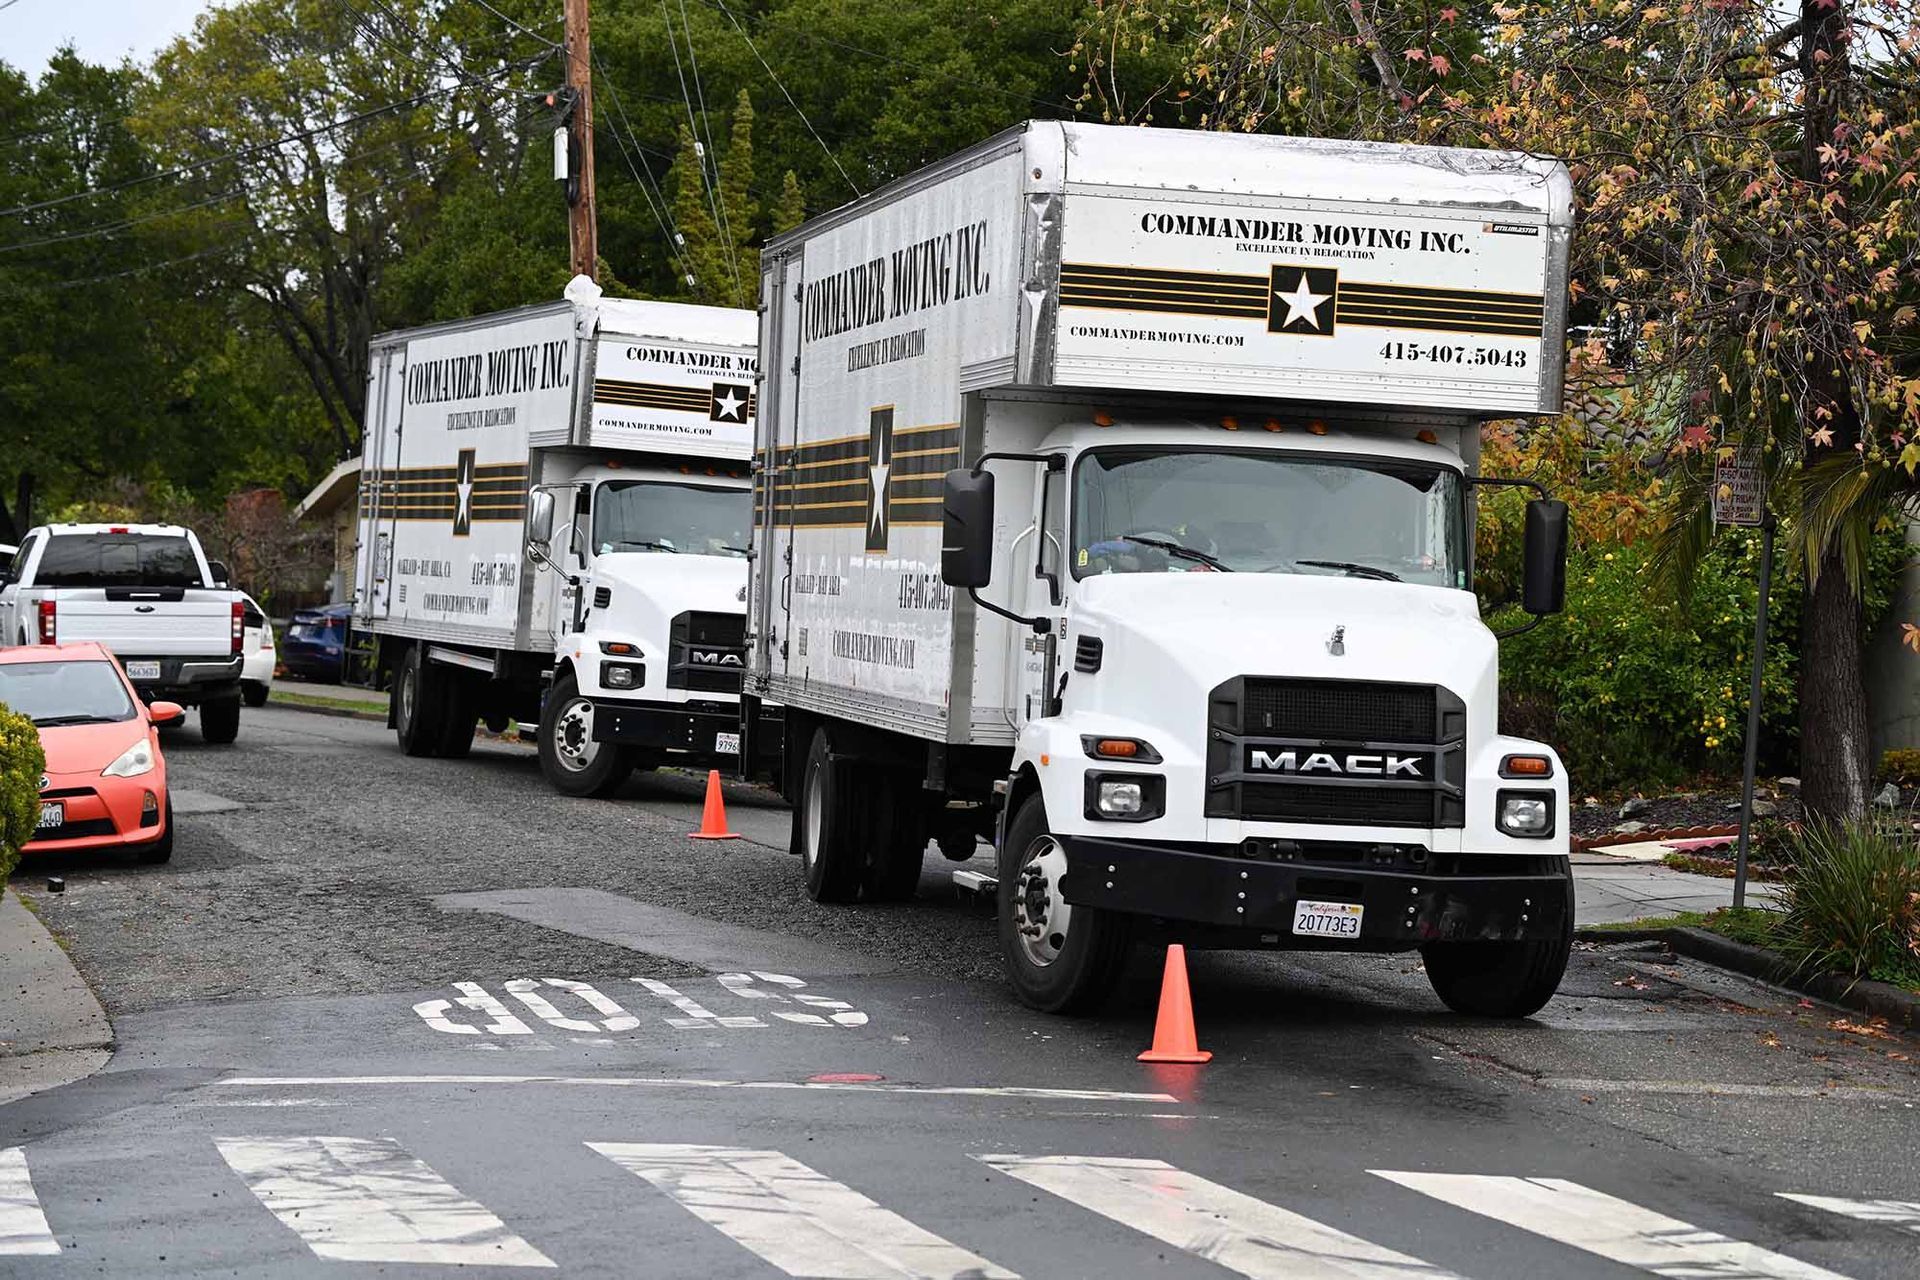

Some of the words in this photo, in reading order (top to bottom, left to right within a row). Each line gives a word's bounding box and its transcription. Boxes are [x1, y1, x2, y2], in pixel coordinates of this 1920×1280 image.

[1140, 212, 1304, 245] COMMANDER
[1309, 224, 1412, 252] MOVING
[1419, 231, 1471, 255] INC.
[1235, 242, 1297, 255] EXCELLENCE
[1299, 246, 1311, 256] IN
[1313, 247, 1376, 260] RELOCATION
[805, 256, 886, 345] COMMANDER
[890, 231, 953, 320] MOVING
[954, 218, 990, 302] INC.
[1069, 325, 1245, 348] COMMANDERMOVING.COM
[627, 346, 732, 370] COMMANDER
[1379, 341, 1528, 369] 415-407.5043
[408, 354, 483, 406] COMMANDER
[485, 344, 538, 397] MOVING
[540, 339, 569, 390] INC.
[687, 368, 726, 377] EXCELLENCE
[598, 418, 713, 436] COMMANDERMOVING.COM
[471, 562, 517, 587] 415-407.5043
[423, 593, 489, 615] COMMANDERMOVING.COM
[832, 630, 915, 670] COMMANDERMOVING.COM
[718, 740, 740, 752] 9796
[1251, 750, 1424, 777] MACK
[1297, 913, 1359, 934] 20773E3
[412, 970, 869, 1036] STOP
